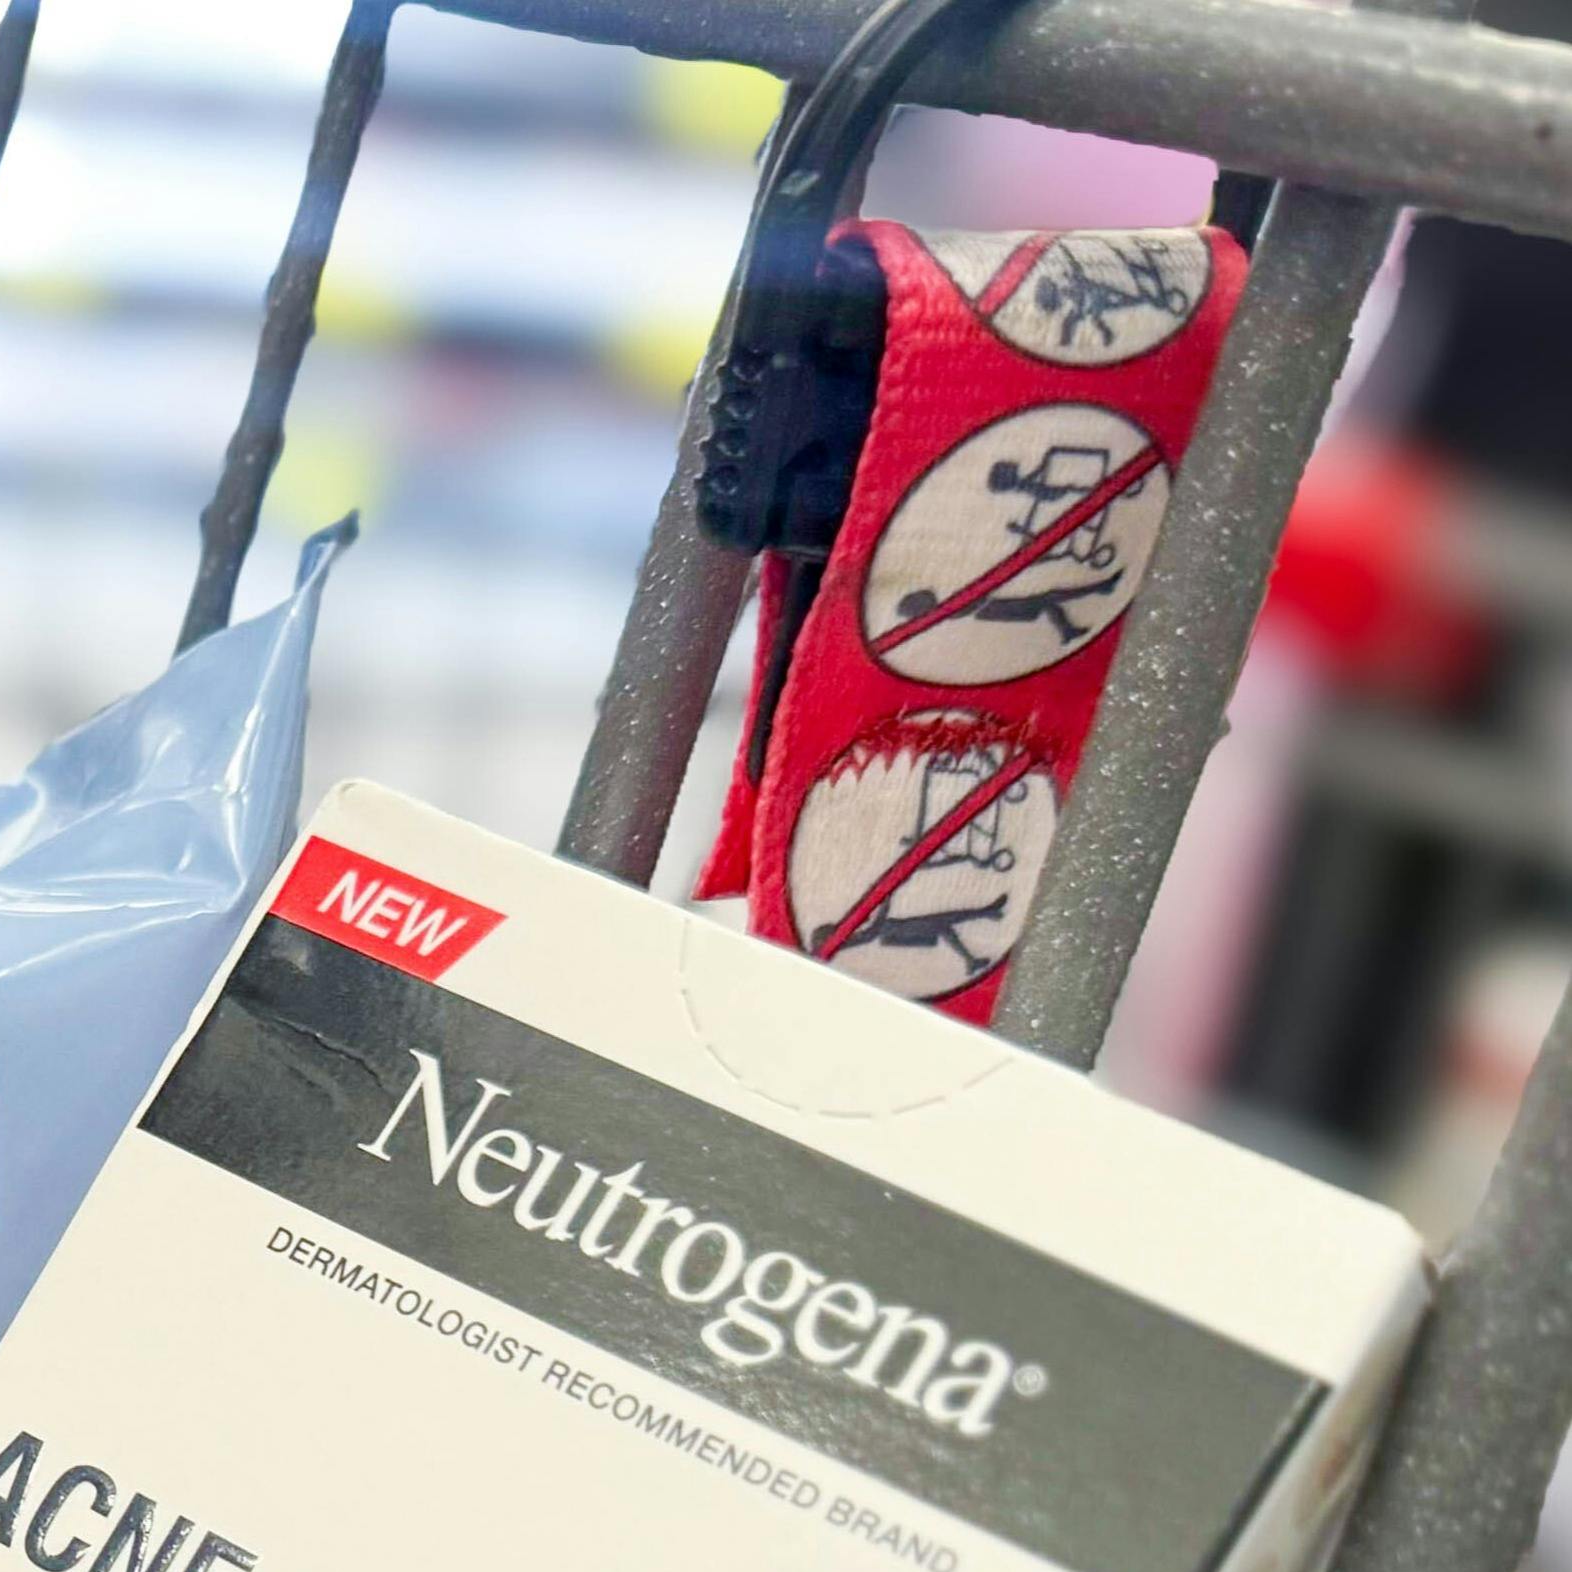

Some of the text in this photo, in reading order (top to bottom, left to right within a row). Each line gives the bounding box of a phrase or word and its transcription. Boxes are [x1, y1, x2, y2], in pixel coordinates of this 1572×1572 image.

[316, 870, 466, 957] NEW
[266, 1226, 542, 1372] DERMATOLOGIST
[541, 1359, 821, 1511] RECOMMENDED
[357, 1048, 1049, 1437] Neutrogena®
